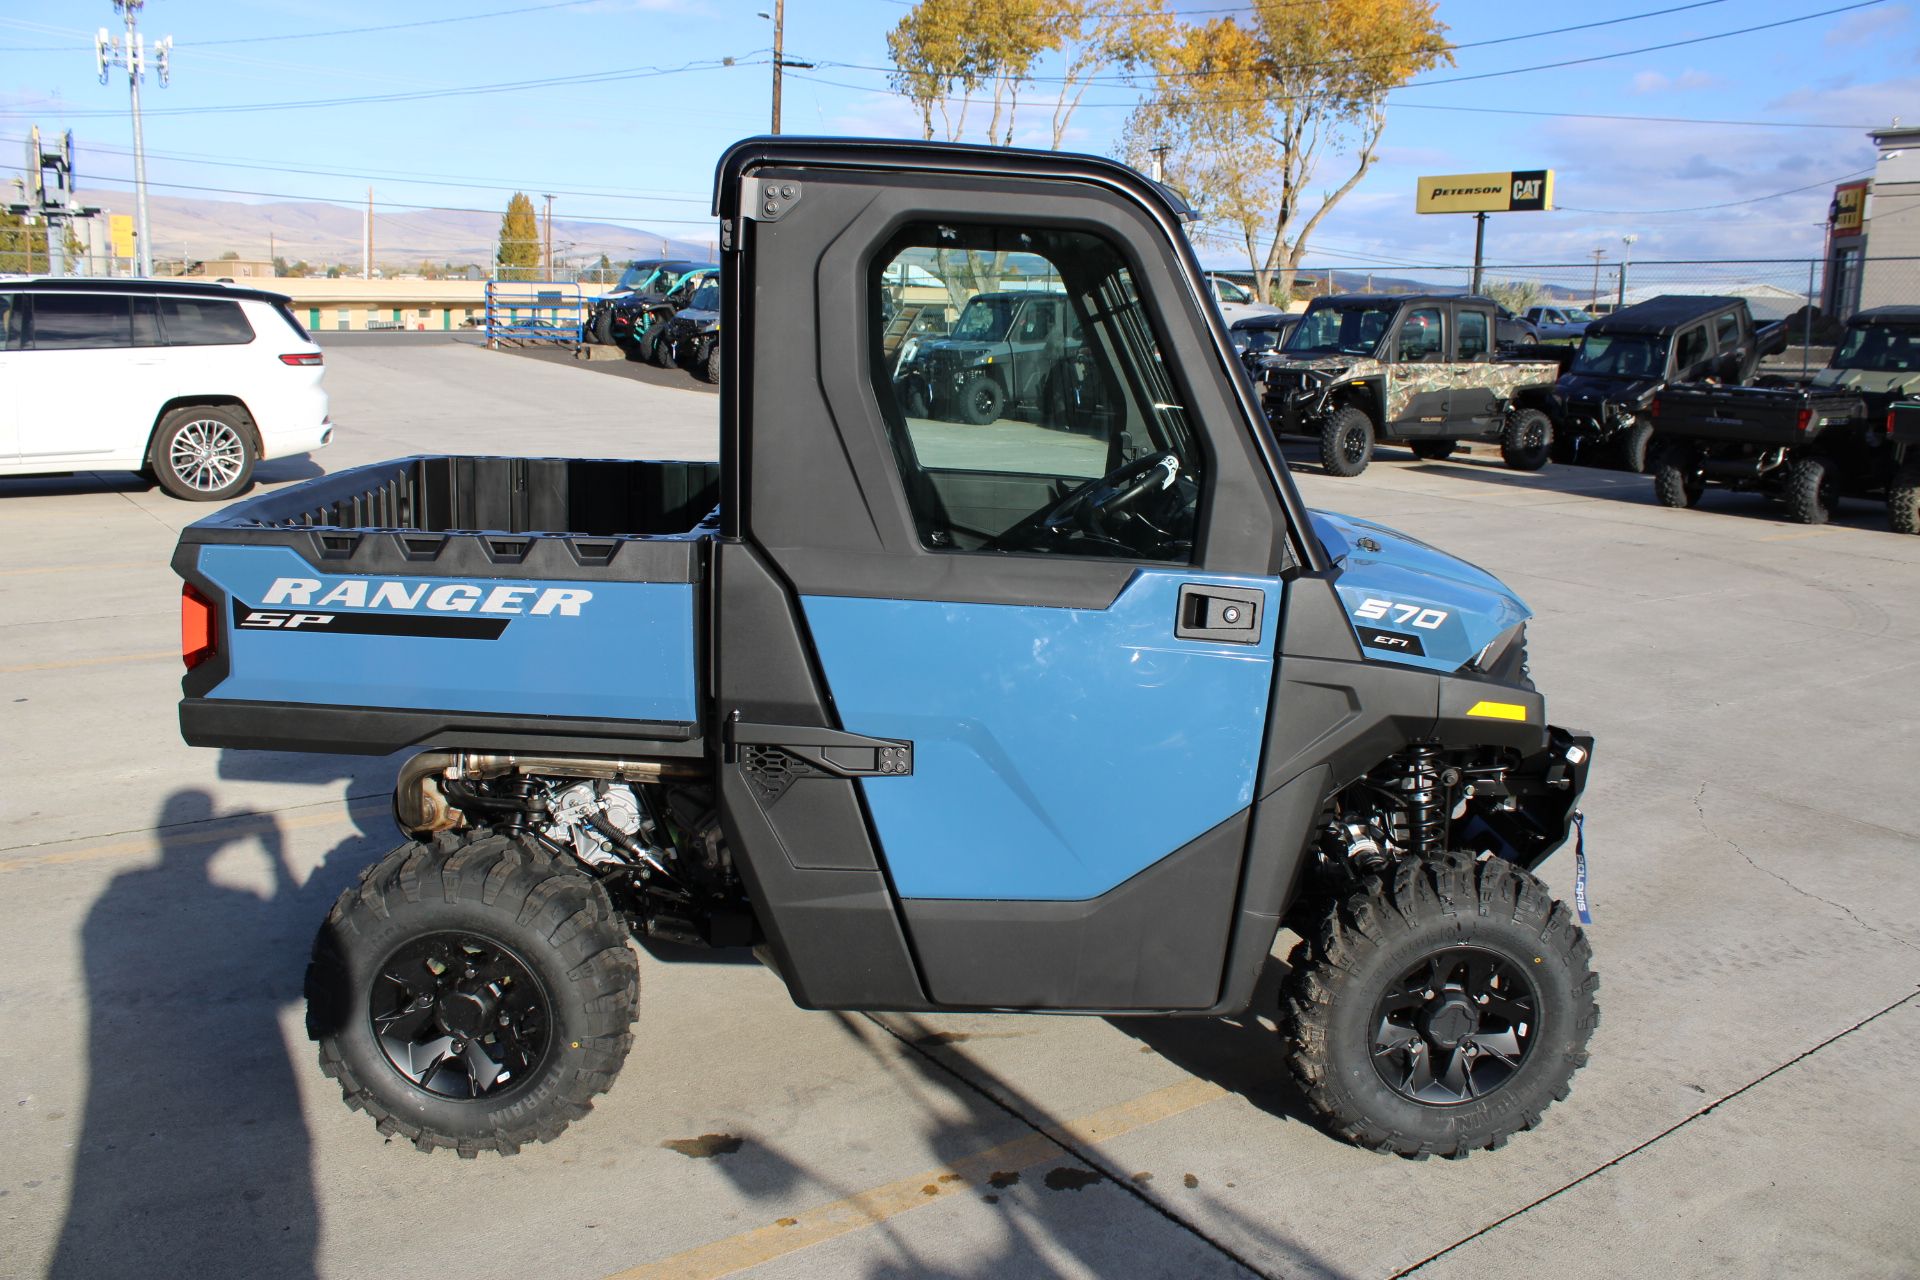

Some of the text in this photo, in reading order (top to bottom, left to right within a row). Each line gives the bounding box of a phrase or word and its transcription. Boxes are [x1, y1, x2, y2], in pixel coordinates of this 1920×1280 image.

[1431, 180, 1542, 200] PETERSON CAT
[261, 577, 594, 617] RANGER
[240, 612, 337, 628] SP
[1354, 598, 1449, 630] 570
[1373, 635, 1410, 648] EFI
[1576, 854, 1588, 912] POLARIS
